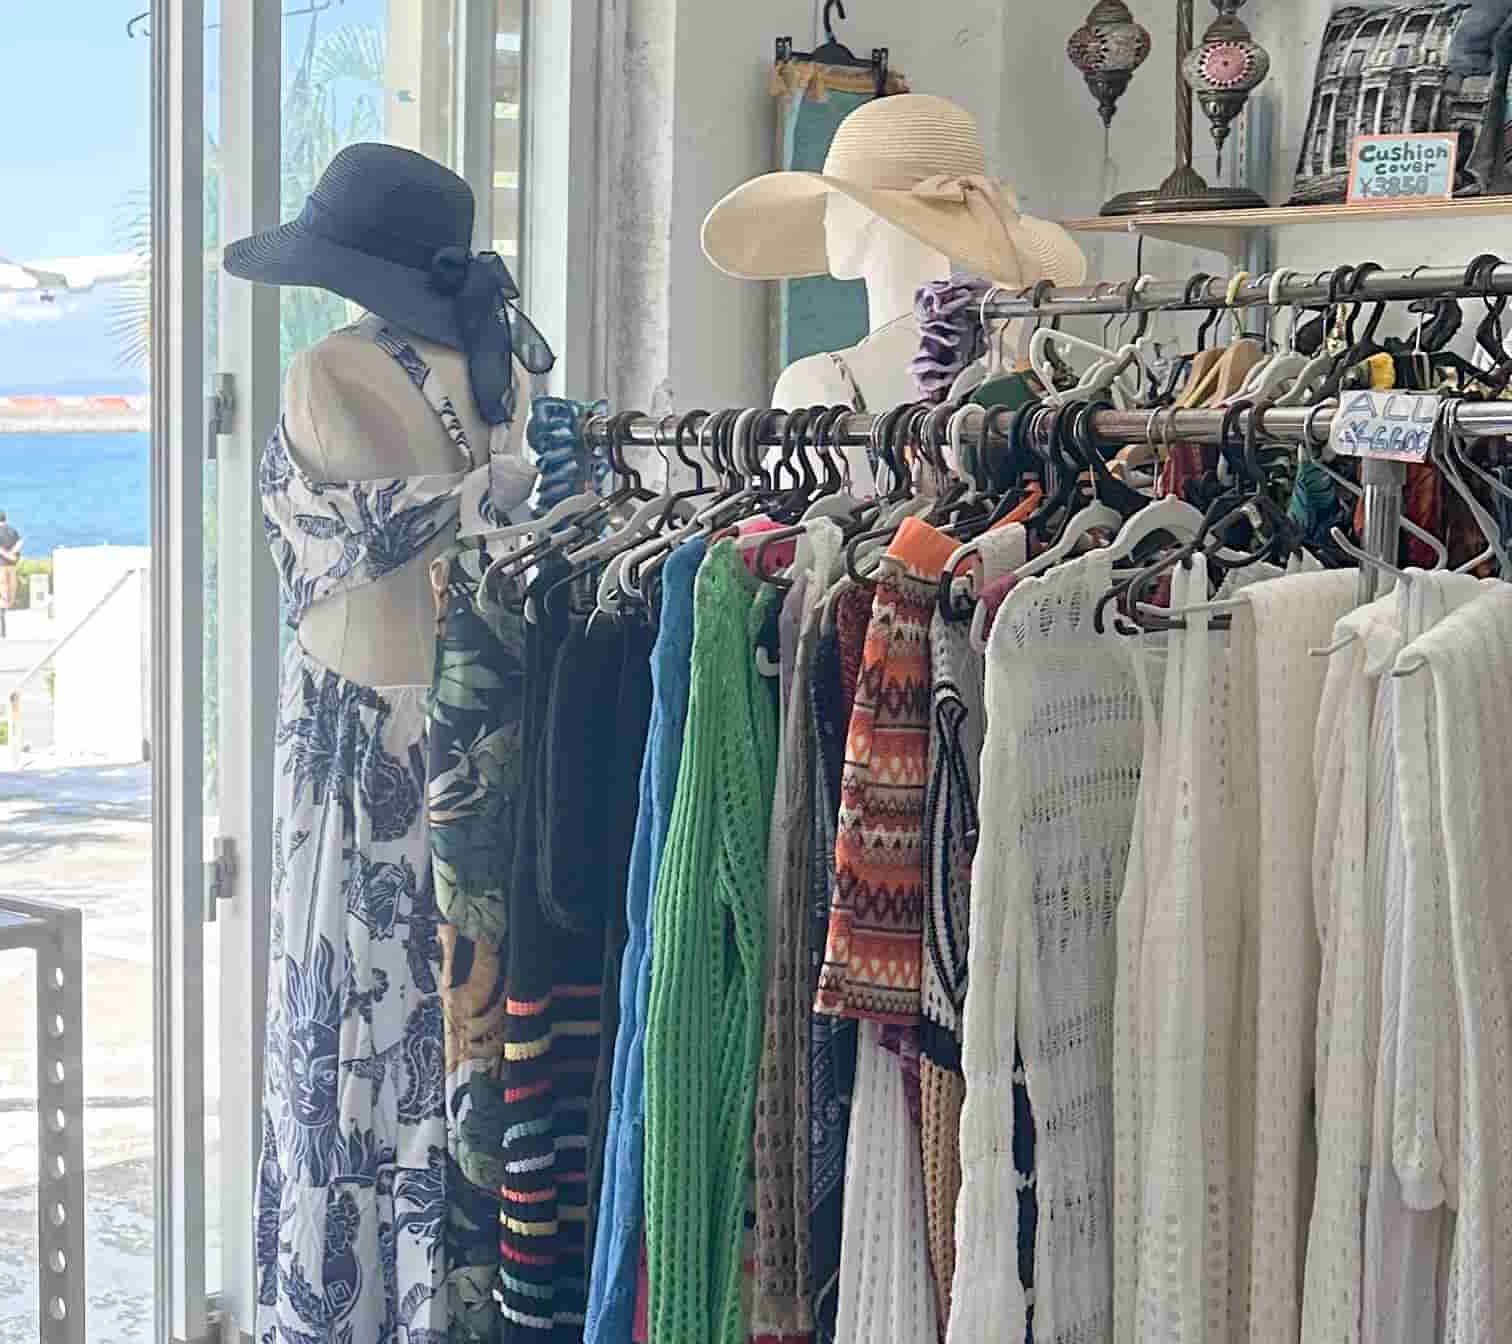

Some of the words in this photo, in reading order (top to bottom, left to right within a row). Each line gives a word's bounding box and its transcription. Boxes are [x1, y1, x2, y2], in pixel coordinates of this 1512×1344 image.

[1359, 141, 1448, 162] Cushion
[1375, 161, 1437, 175] cover
[1342, 391, 1434, 424] ALL
